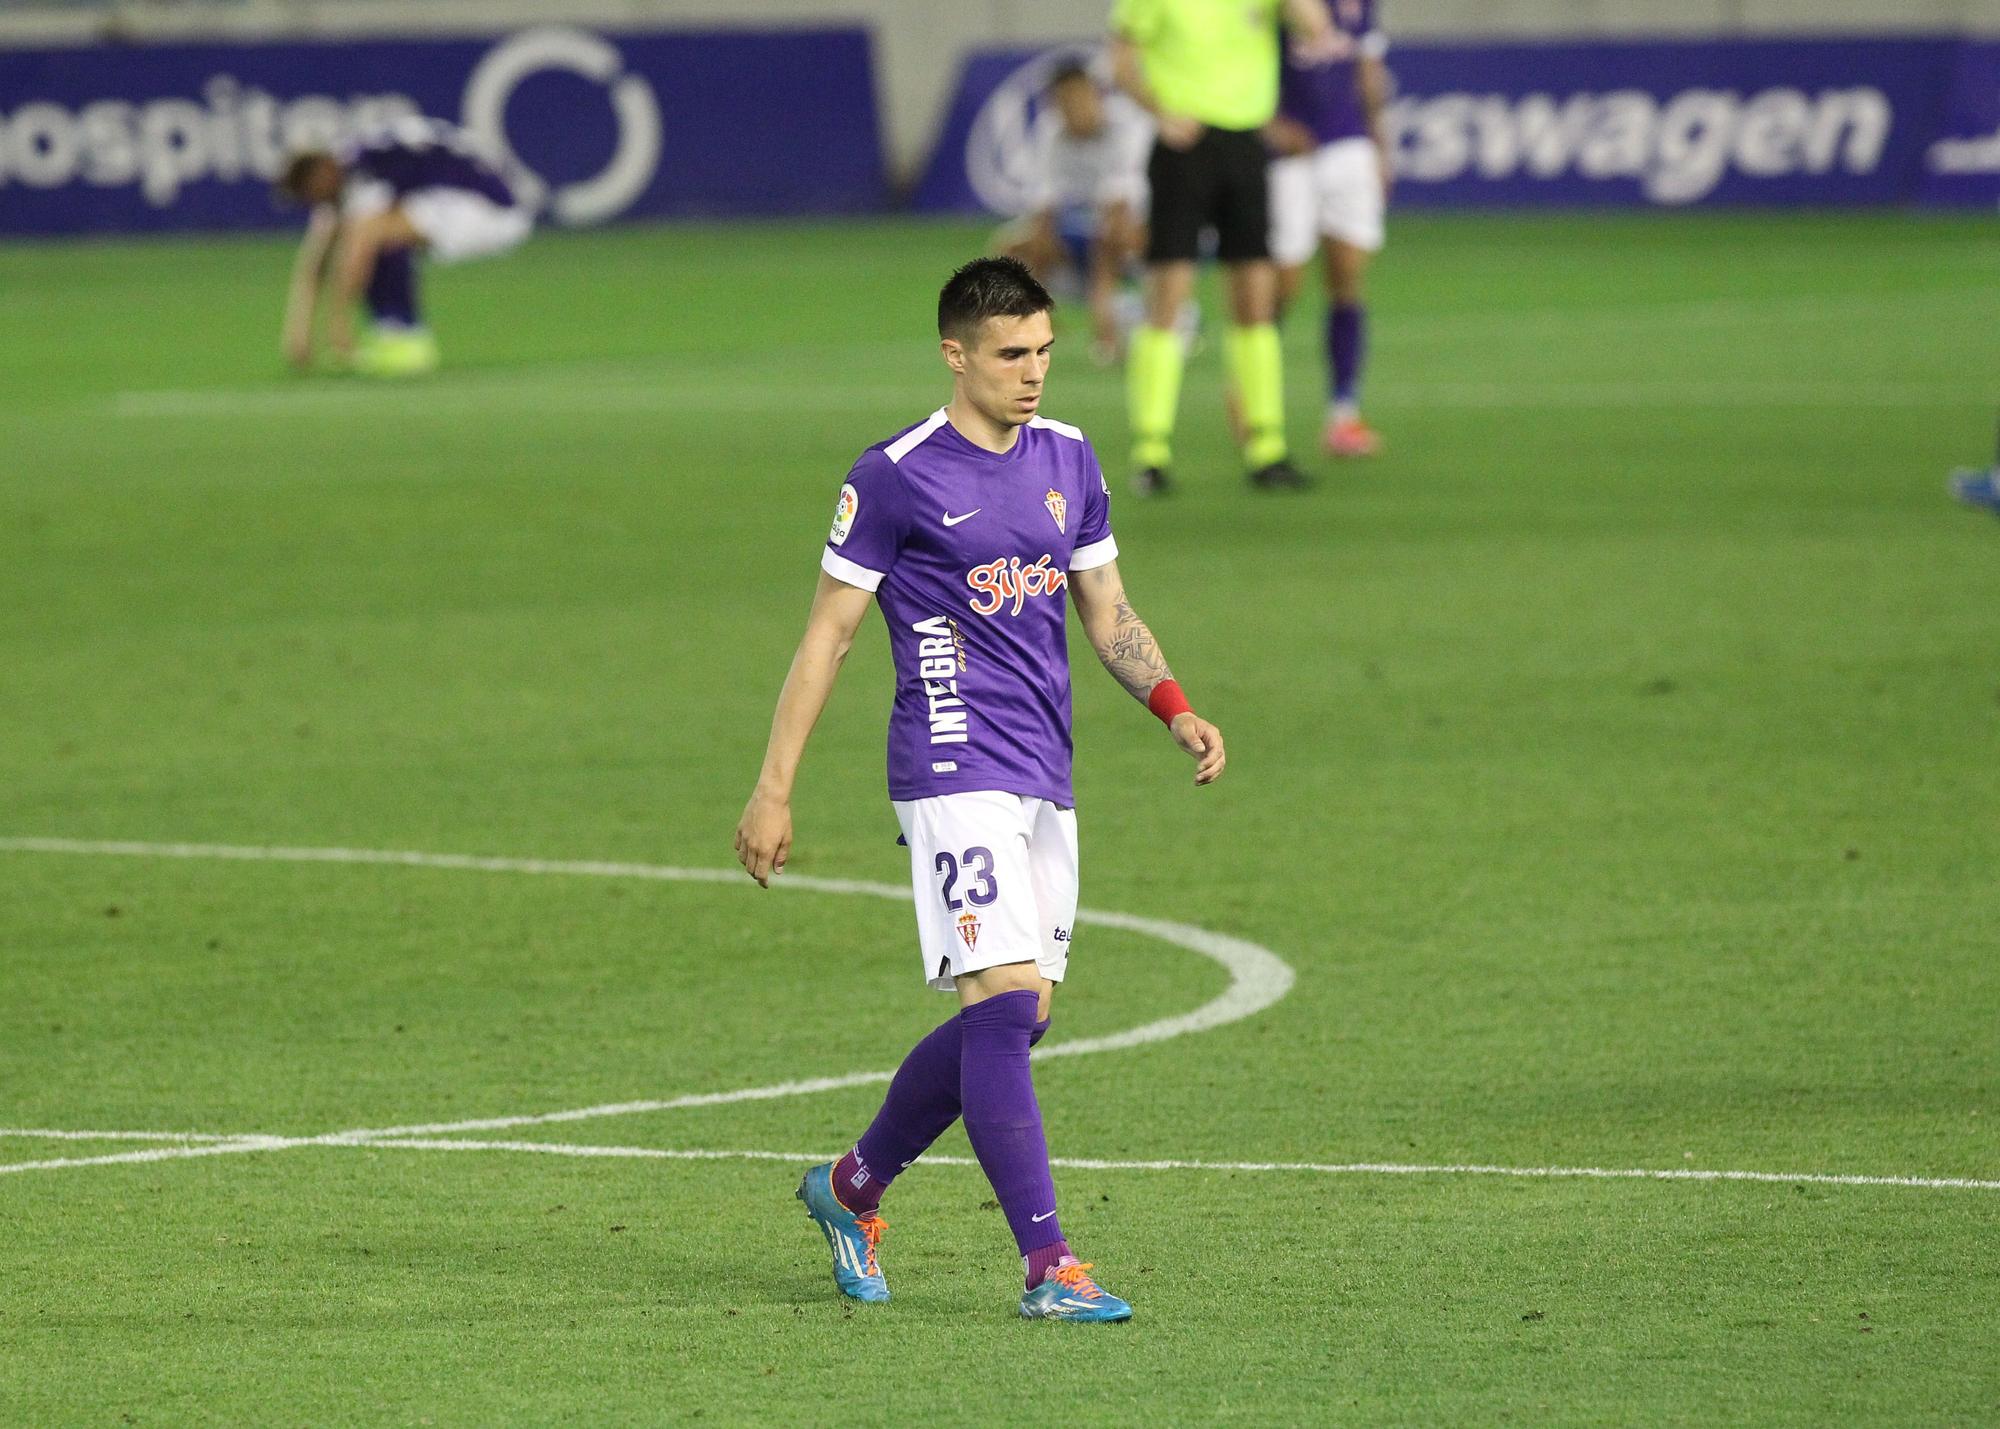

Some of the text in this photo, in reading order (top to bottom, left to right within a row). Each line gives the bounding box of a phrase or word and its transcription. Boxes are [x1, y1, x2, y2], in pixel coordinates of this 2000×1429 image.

[967, 553, 1068, 616] gijón
[912, 615, 968, 745] INTEGRA
[935, 846, 998, 913] 23
[1053, 926, 1072, 942] tel
